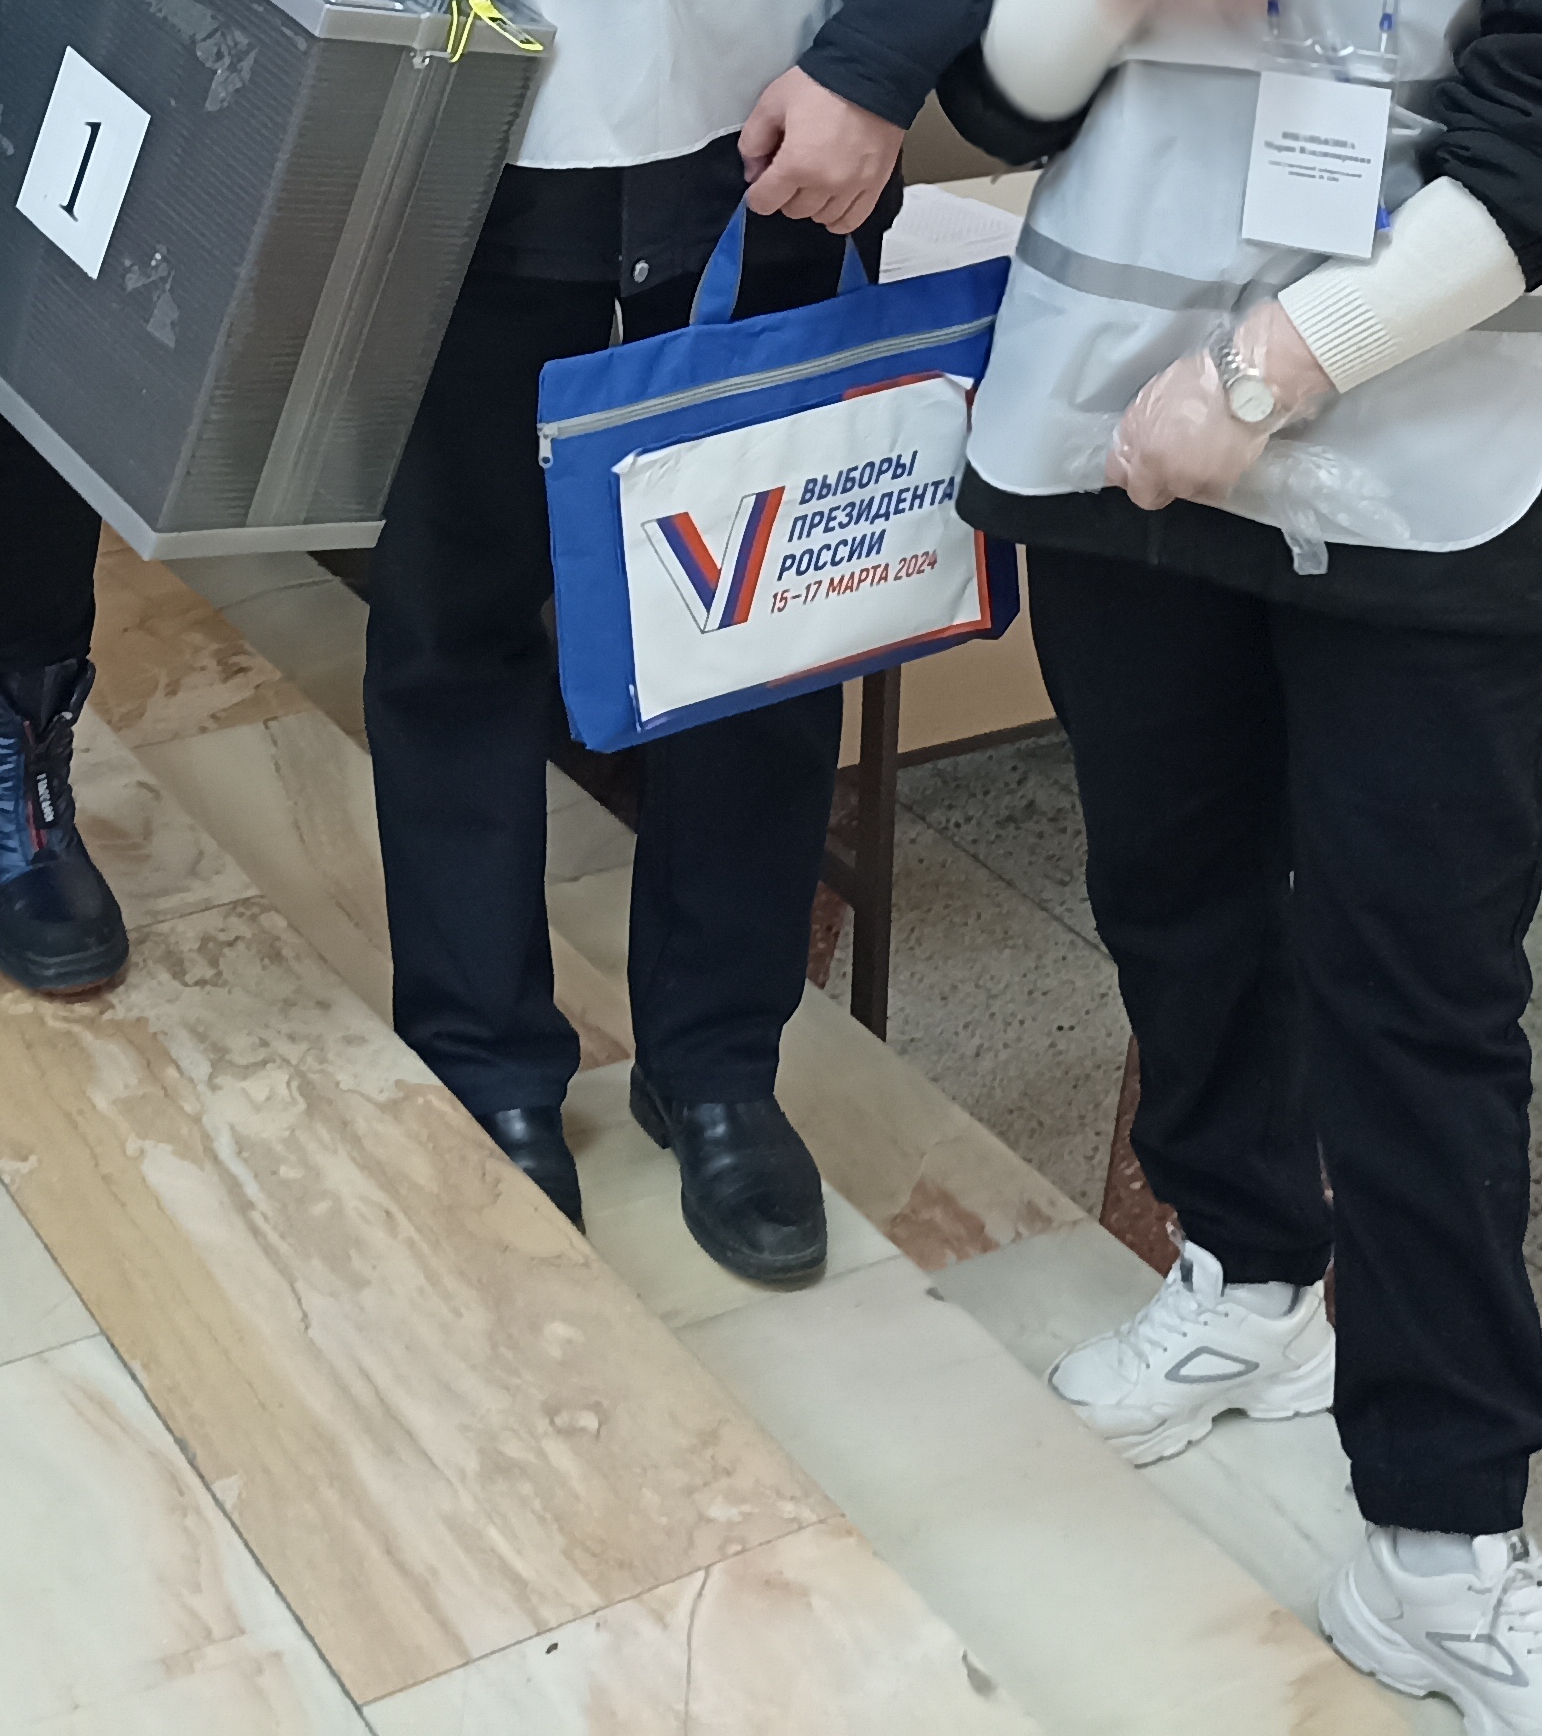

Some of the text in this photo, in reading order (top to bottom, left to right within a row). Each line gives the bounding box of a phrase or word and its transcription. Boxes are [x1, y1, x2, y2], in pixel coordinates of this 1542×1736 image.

[58, 121, 102, 222] 1
[798, 450, 918, 506] ВЫБОРЫ
[788, 476, 955, 543] ПРЕЗИДЕНТА
[777, 529, 886, 583] РОССИИ
[824, 562, 889, 599] МАРТА
[893, 549, 938, 582] 2024
